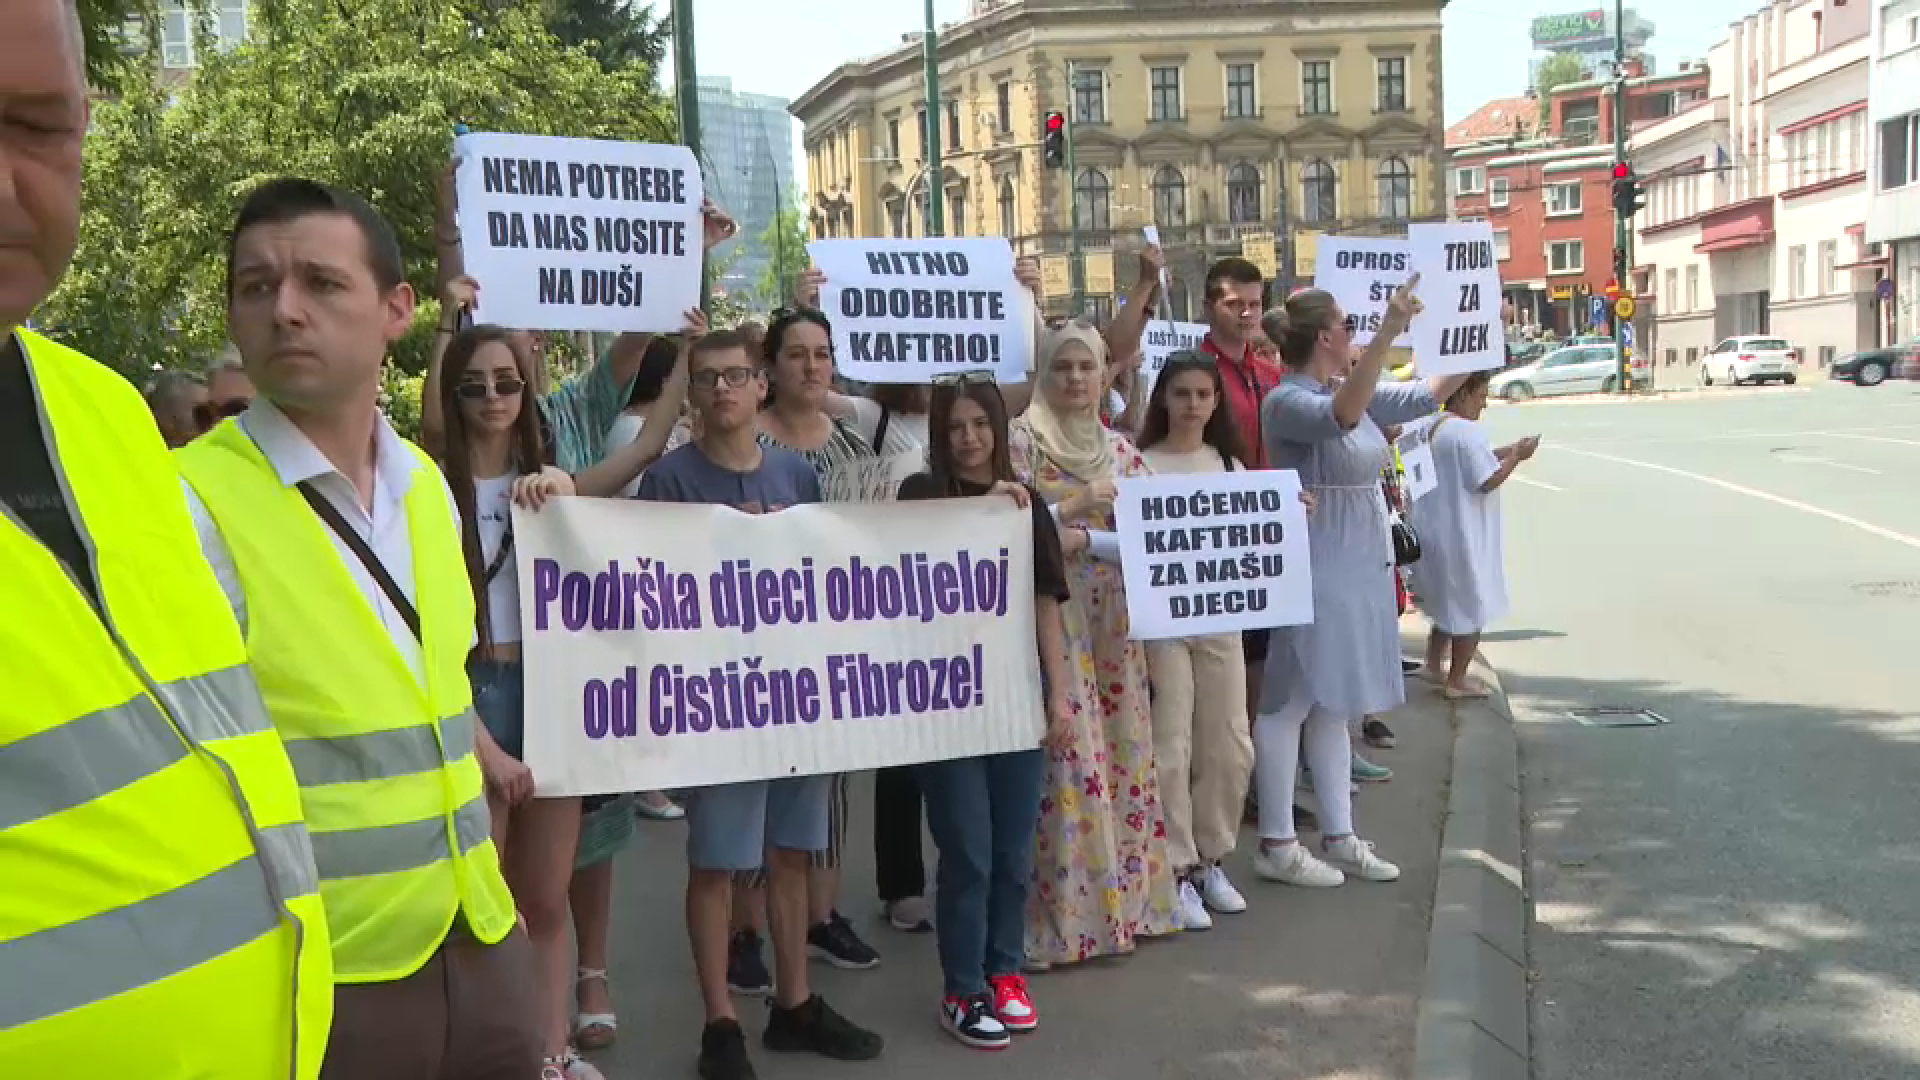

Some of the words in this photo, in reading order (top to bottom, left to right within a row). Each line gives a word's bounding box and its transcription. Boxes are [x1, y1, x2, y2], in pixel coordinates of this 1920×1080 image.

[482, 158, 562, 196] NEMA
[568, 162, 686, 204] POTREBE
[488, 212, 528, 248] DA
[534, 214, 588, 252] NAS
[596, 218, 684, 256] NOSITE
[866, 252, 968, 276] HITNO
[540, 268, 574, 304] NA
[582, 264, 642, 306] DUŠI
[1458, 284, 1480, 312] ZA
[842, 288, 1004, 320] ODOBRITE
[850, 332, 1000, 364] KAFTRIO!
[1440, 324, 1488, 356] LIJEK
[1142, 490, 1280, 520] HOĆEMO
[1144, 522, 1282, 554] KAFTRIO
[1150, 562, 1188, 586] ZA
[1196, 552, 1282, 582] NAŠU
[534, 558, 702, 632] Podrška
[710, 558, 818, 634] djeci
[826, 548, 1008, 622] oboljeloj
[1170, 588, 1266, 618] DJECU
[584, 666, 636, 738] od
[650, 656, 820, 736] Cistične
[826, 644, 984, 720] Fibroze!
